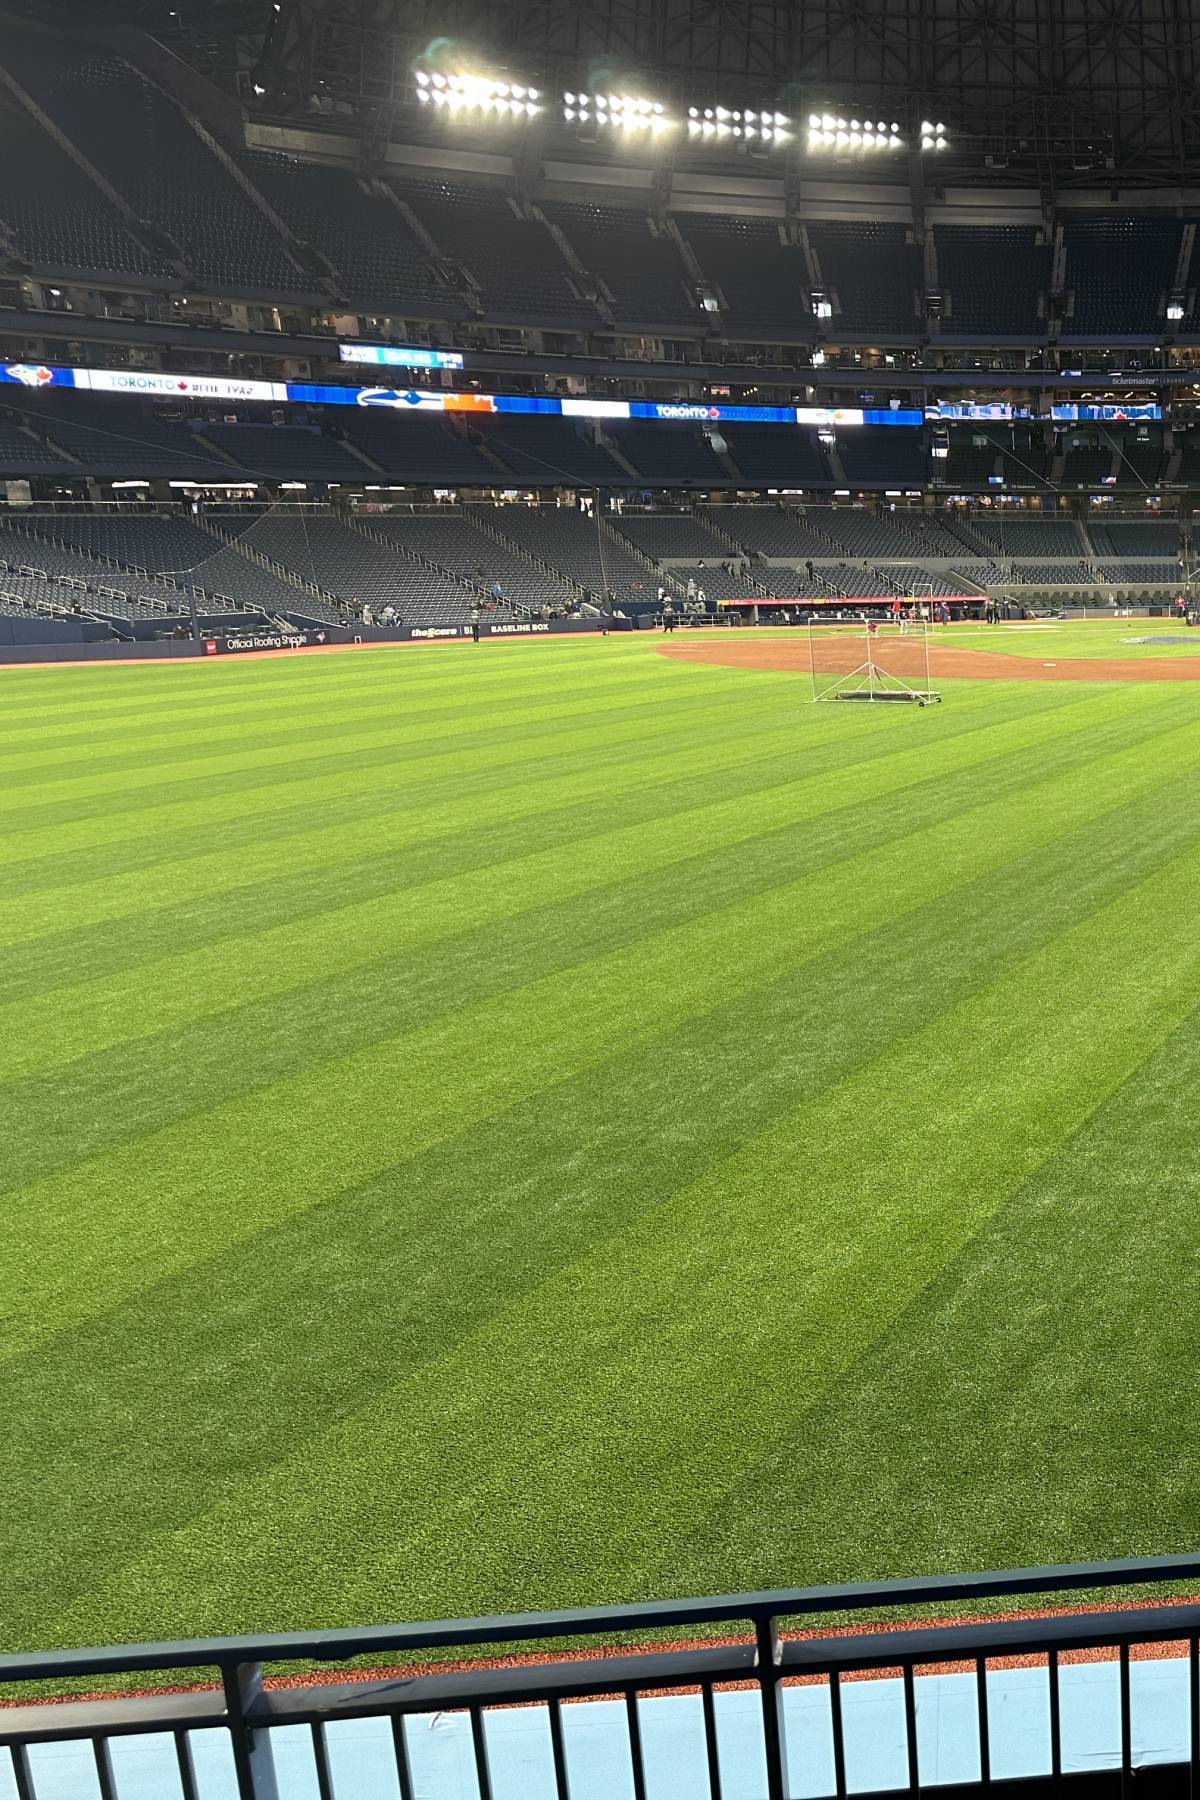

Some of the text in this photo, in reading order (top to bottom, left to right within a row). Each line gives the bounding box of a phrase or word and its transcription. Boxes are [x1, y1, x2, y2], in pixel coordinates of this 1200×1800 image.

[110, 375, 175, 390] TORONTO
[1112, 377, 1155, 385] ticketmaster
[656, 405, 709, 418] TORONTO
[411, 627, 458, 638] theScore
[491, 623, 549, 633] BASELINE BOX
[227, 638, 254, 650] Official
[254, 636, 281, 648] Roofing
